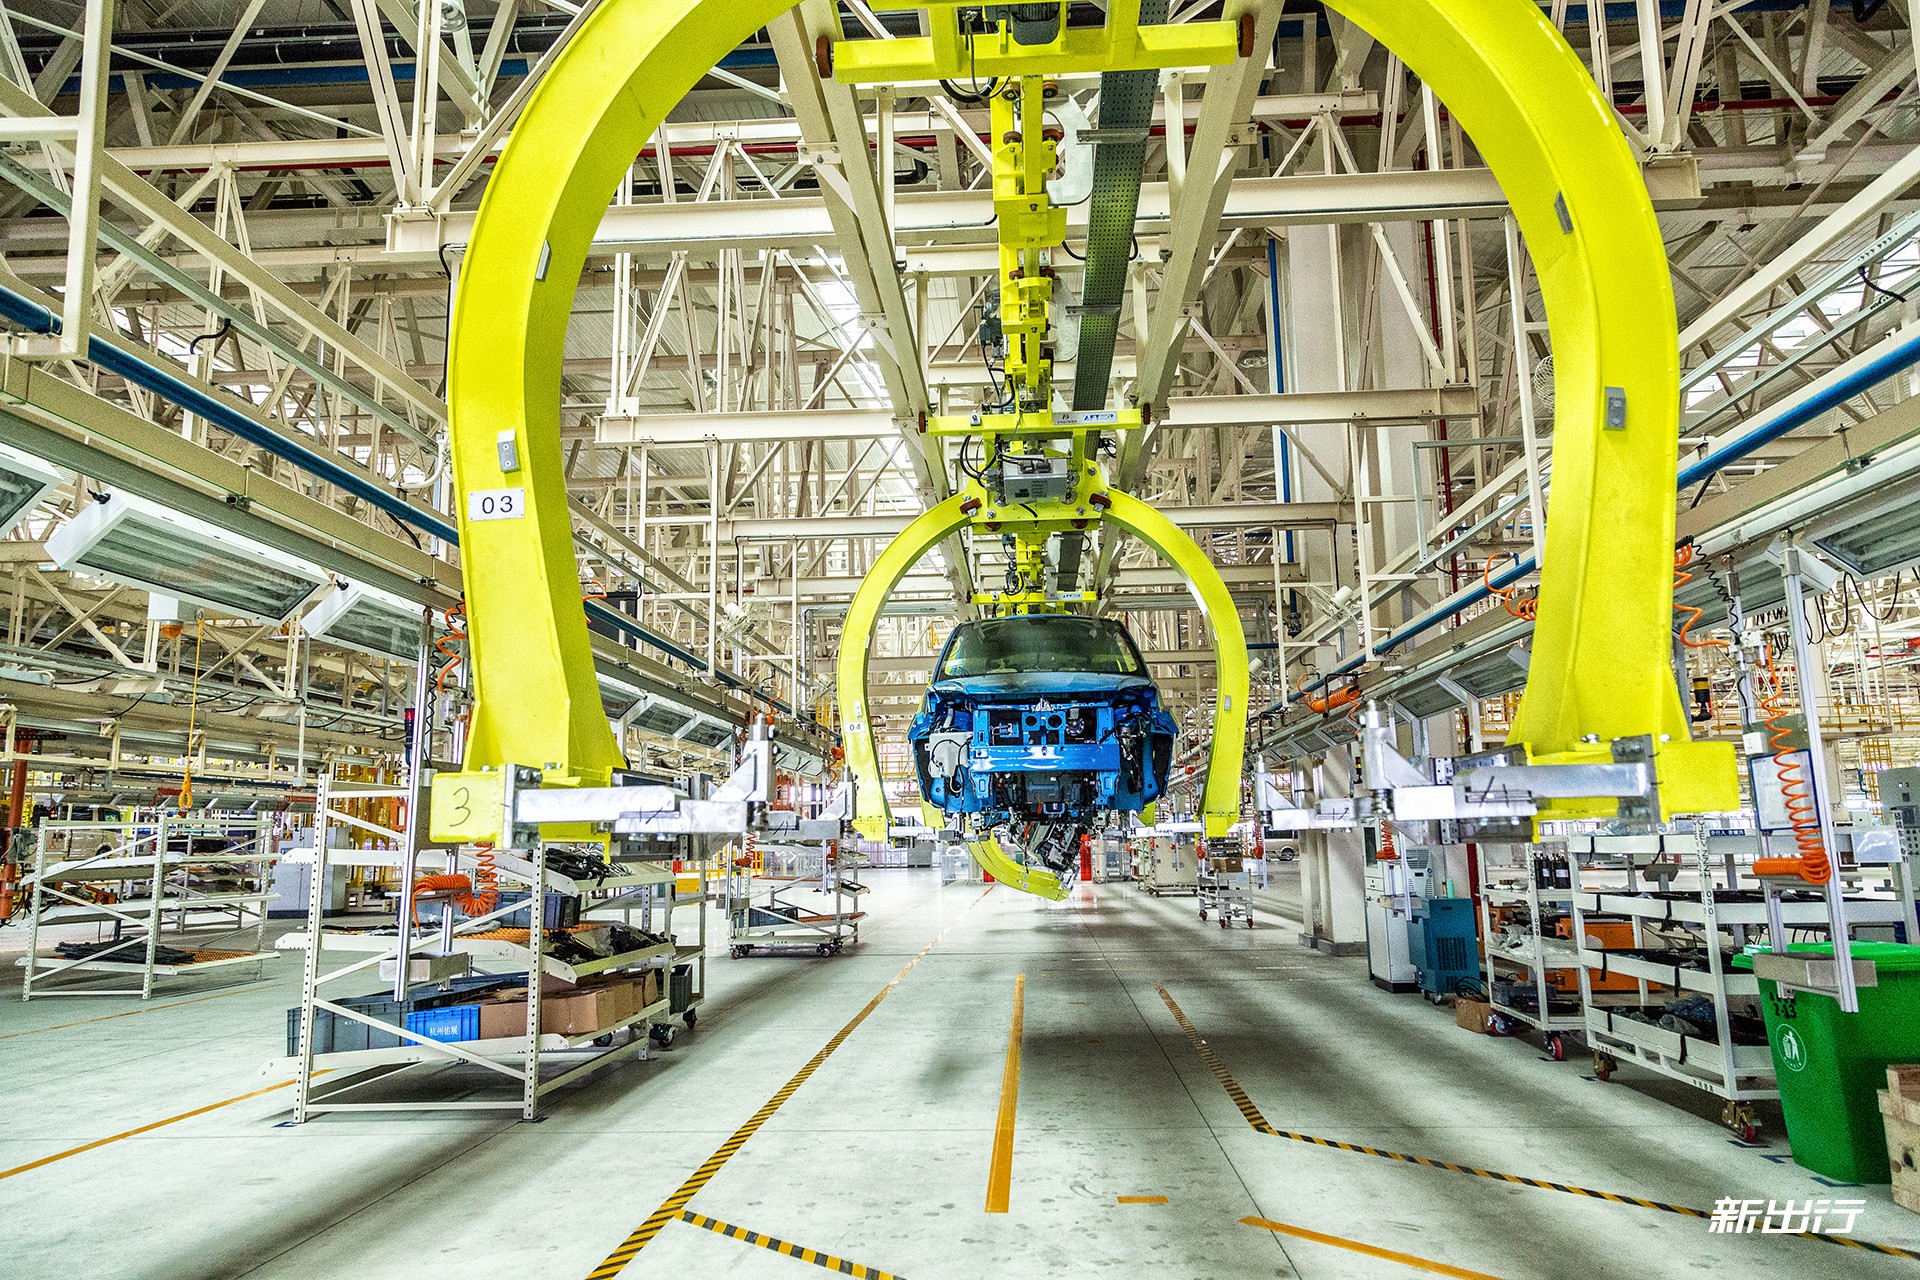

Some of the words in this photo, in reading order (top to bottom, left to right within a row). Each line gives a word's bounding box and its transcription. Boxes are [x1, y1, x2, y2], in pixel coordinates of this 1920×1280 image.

[482, 495, 513, 515] 03
[850, 723, 861, 731] 04
[449, 786, 471, 828] 3
